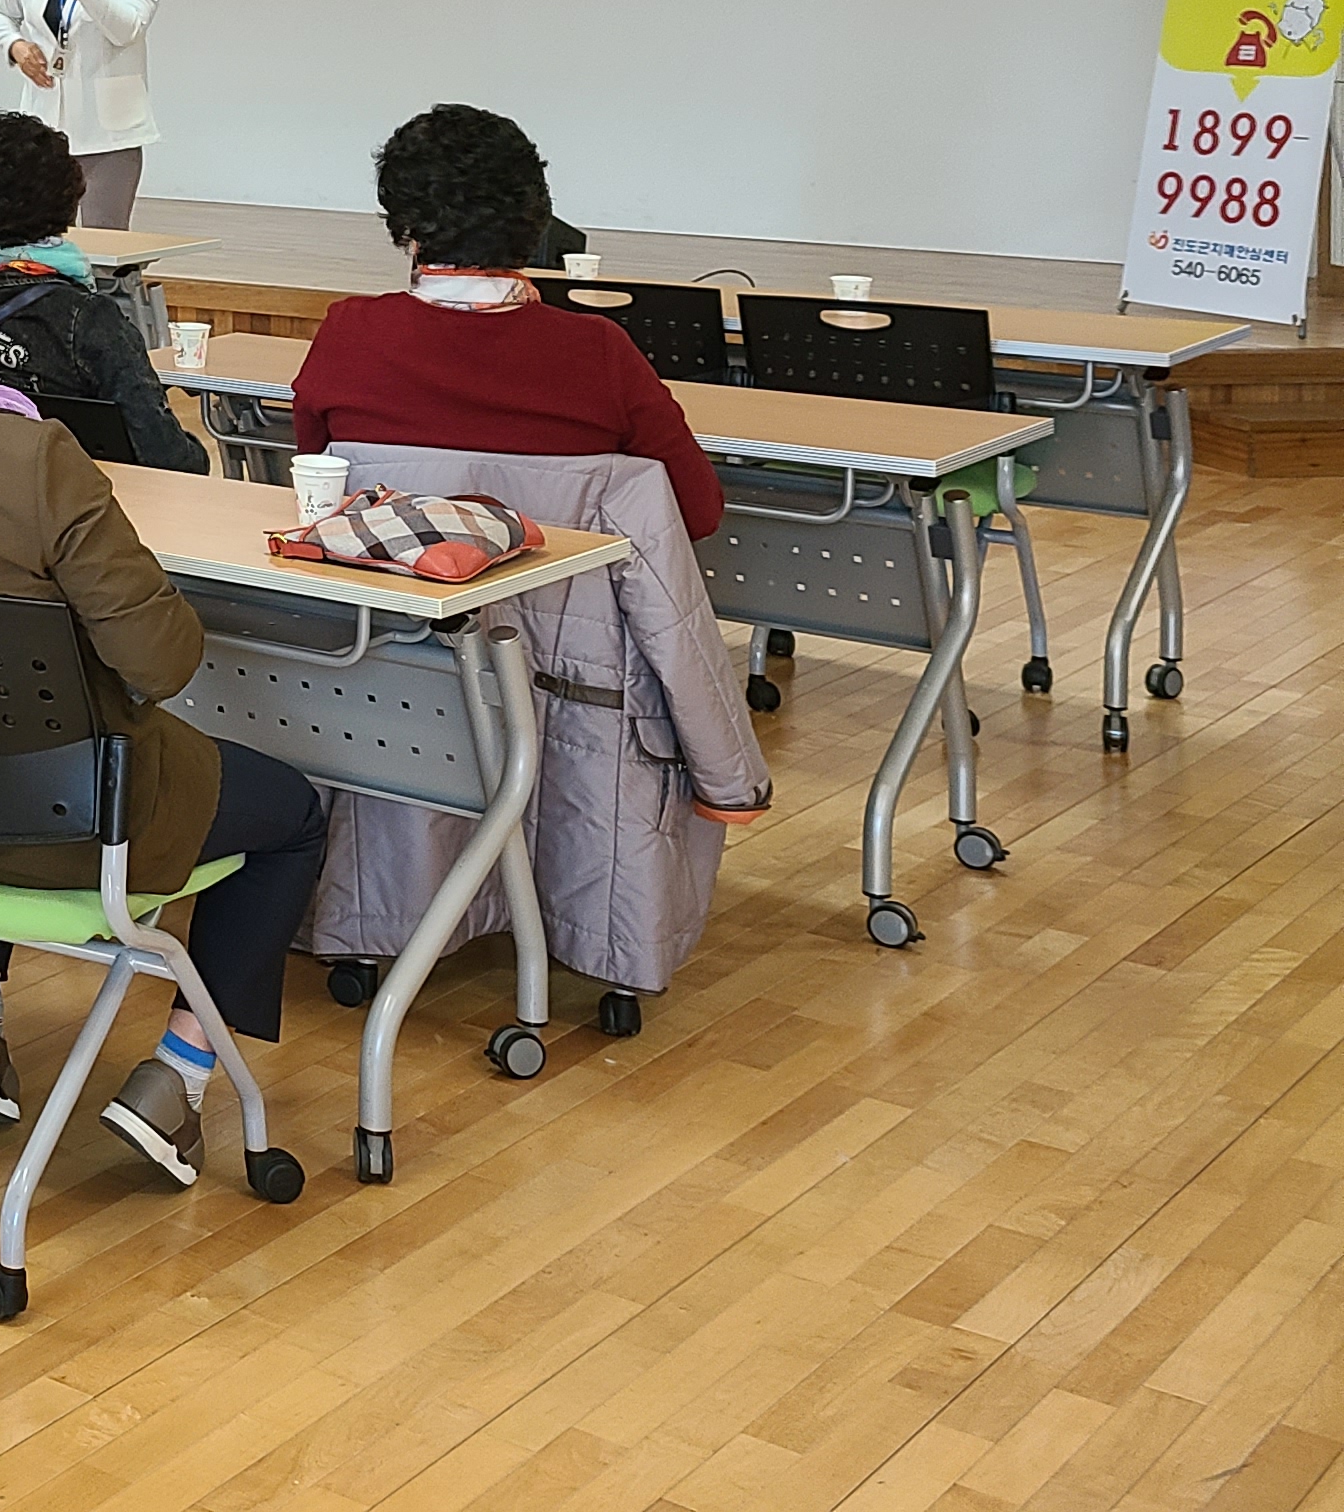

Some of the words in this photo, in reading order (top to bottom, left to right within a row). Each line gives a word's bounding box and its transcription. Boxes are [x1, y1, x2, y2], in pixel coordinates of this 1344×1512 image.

[1157, 171, 1281, 227] 9988
[1172, 238, 1289, 264] 진도군치매안심센터
[1172, 261, 1262, 286] 540-6065
